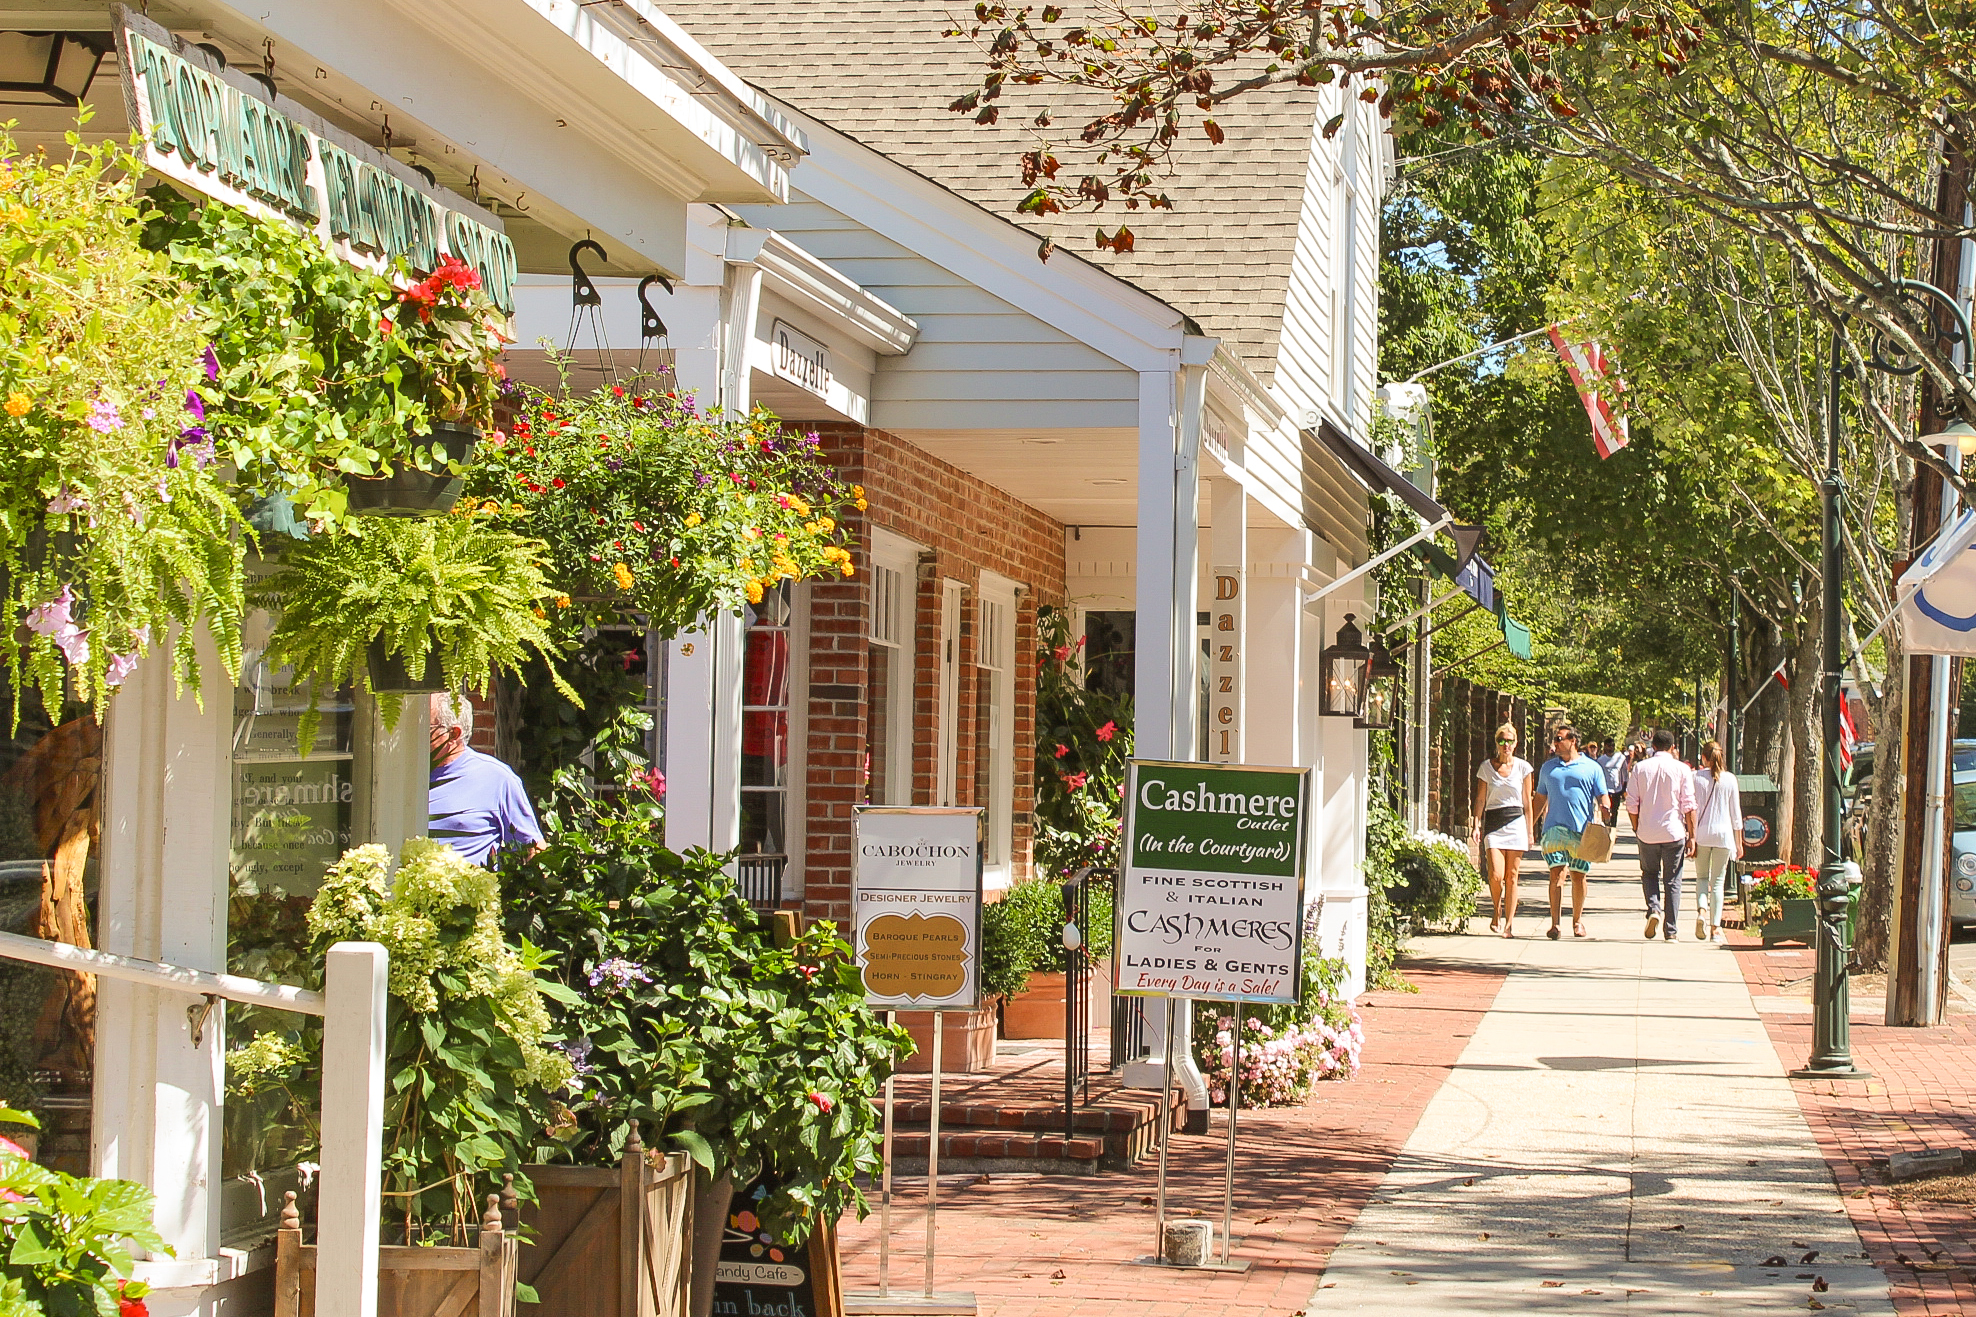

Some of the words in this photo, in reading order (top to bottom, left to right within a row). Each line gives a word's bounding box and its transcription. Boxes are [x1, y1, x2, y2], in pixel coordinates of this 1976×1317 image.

[130, 33, 320, 225] TOPIAIRE
[318, 139, 438, 277] FLOWER
[445, 209, 518, 317] SHOP
[779, 330, 830, 395] Dazzelle
[1206, 575, 1239, 763] Dazzel
[259, 773, 276, 783] and
[1141, 780, 1295, 818] Cashmere
[255, 818, 273, 828] But
[1236, 818, 1290, 832] Outlet
[242, 840, 278, 850] because
[862, 844, 971, 858] CABOCHON
[1140, 833, 1162, 853] (In
[1168, 835, 1195, 854] the
[1200, 838, 1291, 863] Courtyard)
[245, 862, 268, 875] ugly,
[273, 863, 304, 875] except
[1142, 876, 1186, 887] FINE
[1192, 878, 1283, 891] SCOTTISH
[860, 892, 917, 903] DESIGNER
[919, 893, 972, 904] JEWELRY
[1166, 891, 1179, 903] &
[1188, 894, 1263, 907] ITALIAN
[872, 932, 918, 941] BAROQUE
[922, 933, 959, 942] PEARLS
[869, 952, 929, 961] SEMI-PRECIOUS
[931, 953, 961, 961] STONES
[1127, 954, 1197, 970] LADIES
[1204, 958, 1218, 971] &
[1225, 960, 1289, 975] GENTS
[872, 972, 900, 980] HORN
[910, 972, 958, 981] STINGRAY
[1136, 972, 1178, 992] Every
[1182, 975, 1211, 993] Day
[1214, 978, 1224, 993] is
[1228, 983, 1237, 992] a
[1240, 978, 1280, 995] Sale!
[716, 1265, 750, 1281] andy
[754, 1265, 788, 1280] Cafe
[744, 1289, 807, 1317] back
